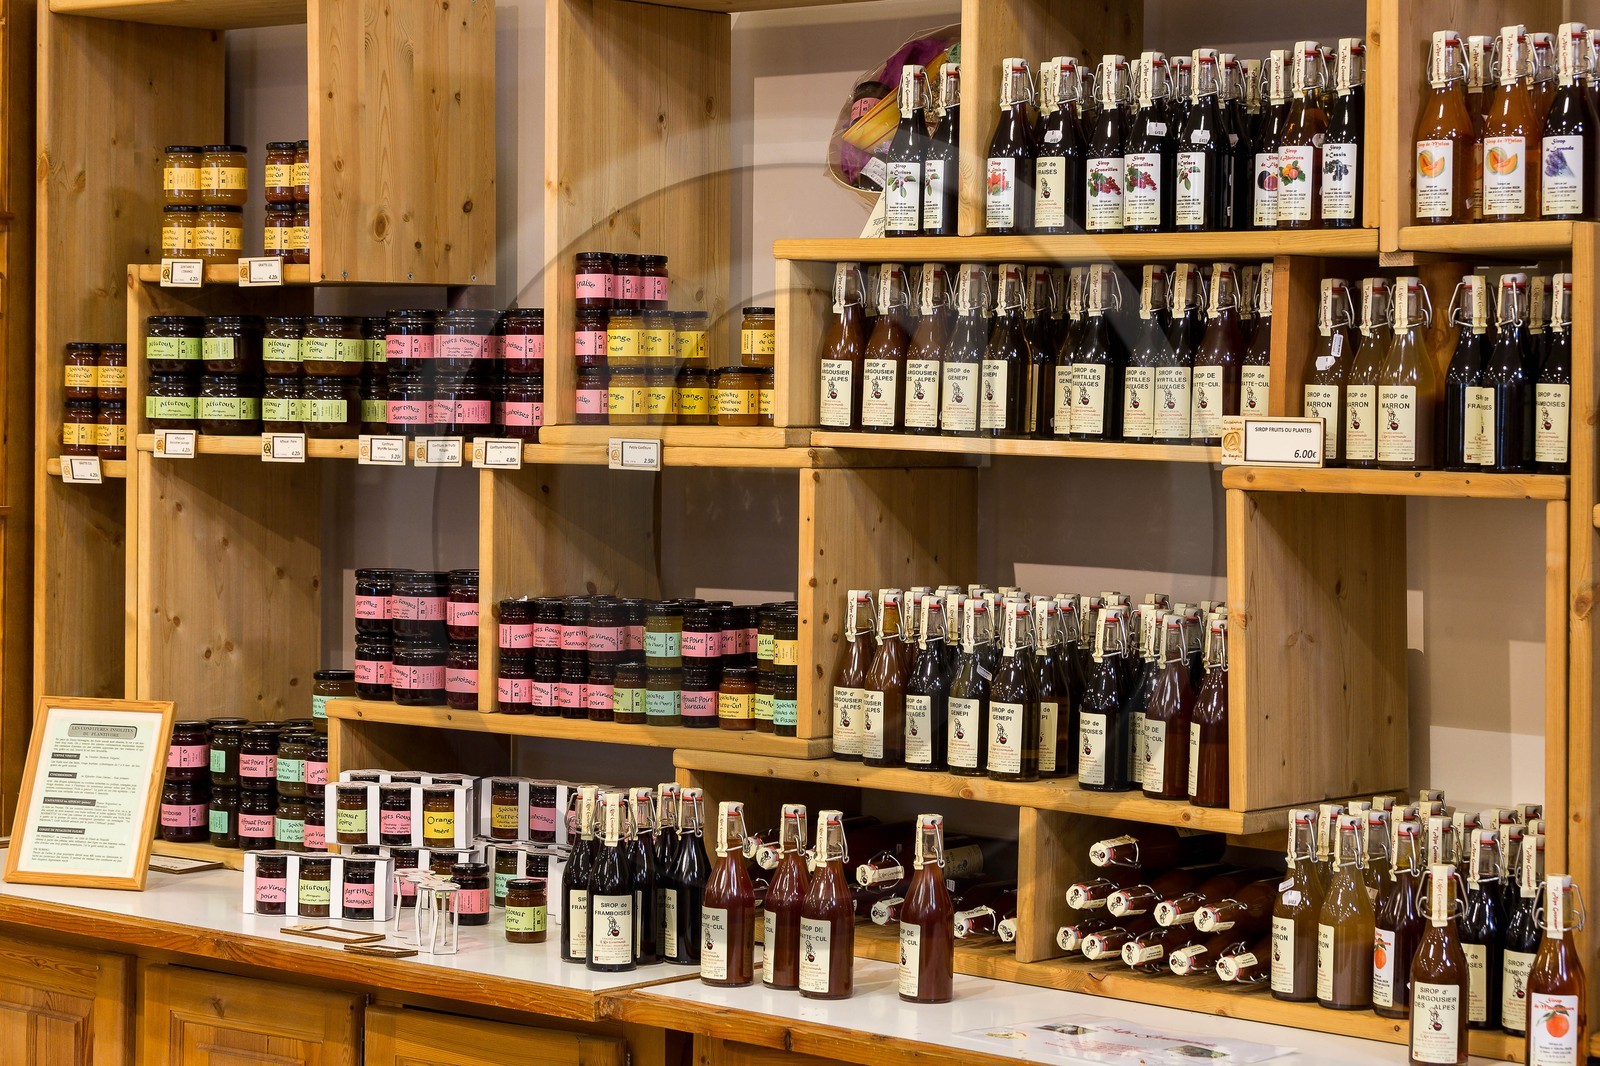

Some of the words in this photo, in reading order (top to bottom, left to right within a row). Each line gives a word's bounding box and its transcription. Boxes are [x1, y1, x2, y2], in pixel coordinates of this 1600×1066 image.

[1294, 449, 1316, 459] 6.00€
[712, 914, 720, 922] DE
[1419, 986, 1441, 994] SIROP
[1417, 994, 1457, 1003] ARGOUSIER
